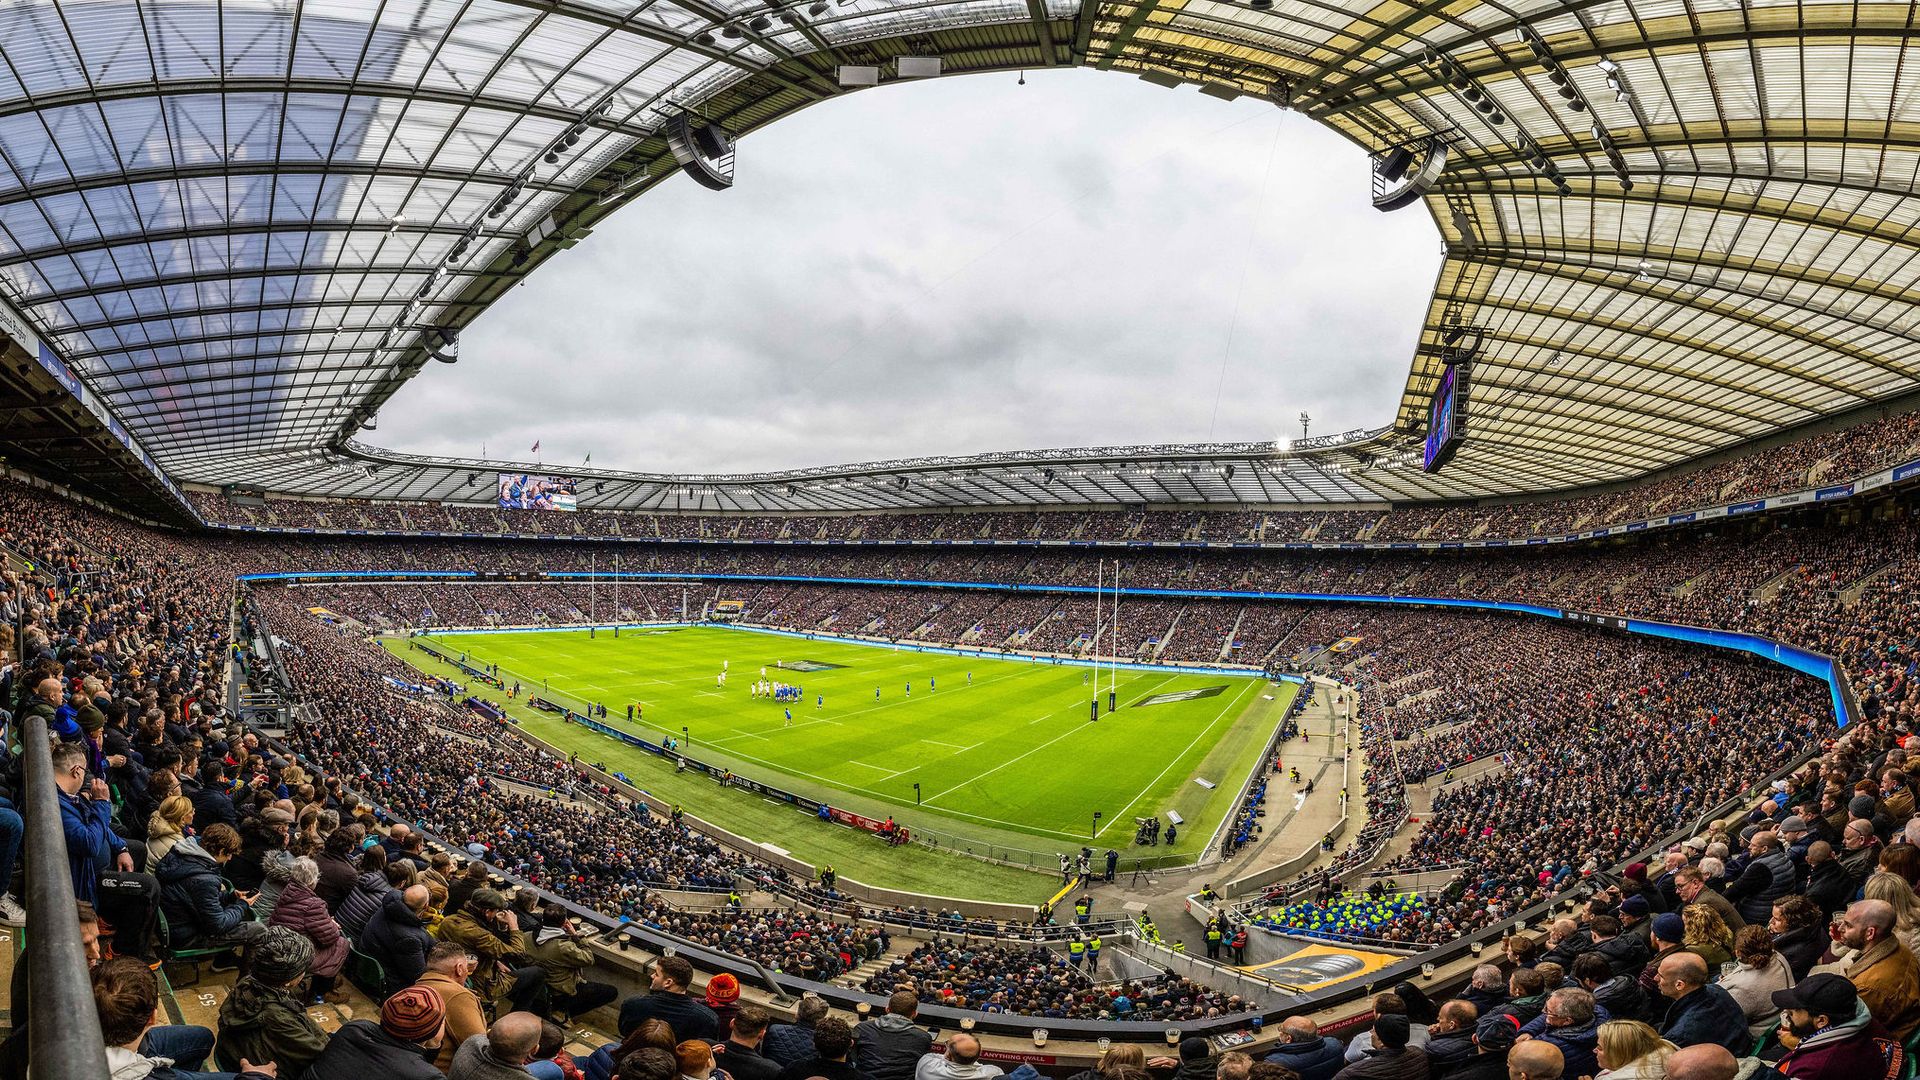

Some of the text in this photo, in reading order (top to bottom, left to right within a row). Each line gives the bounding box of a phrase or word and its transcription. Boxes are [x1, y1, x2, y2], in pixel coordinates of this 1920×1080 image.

[198, 993, 217, 1007] 55
[1334, 1020, 1353, 1029] PLACE
[983, 1051, 1022, 1061] ANYTHING
